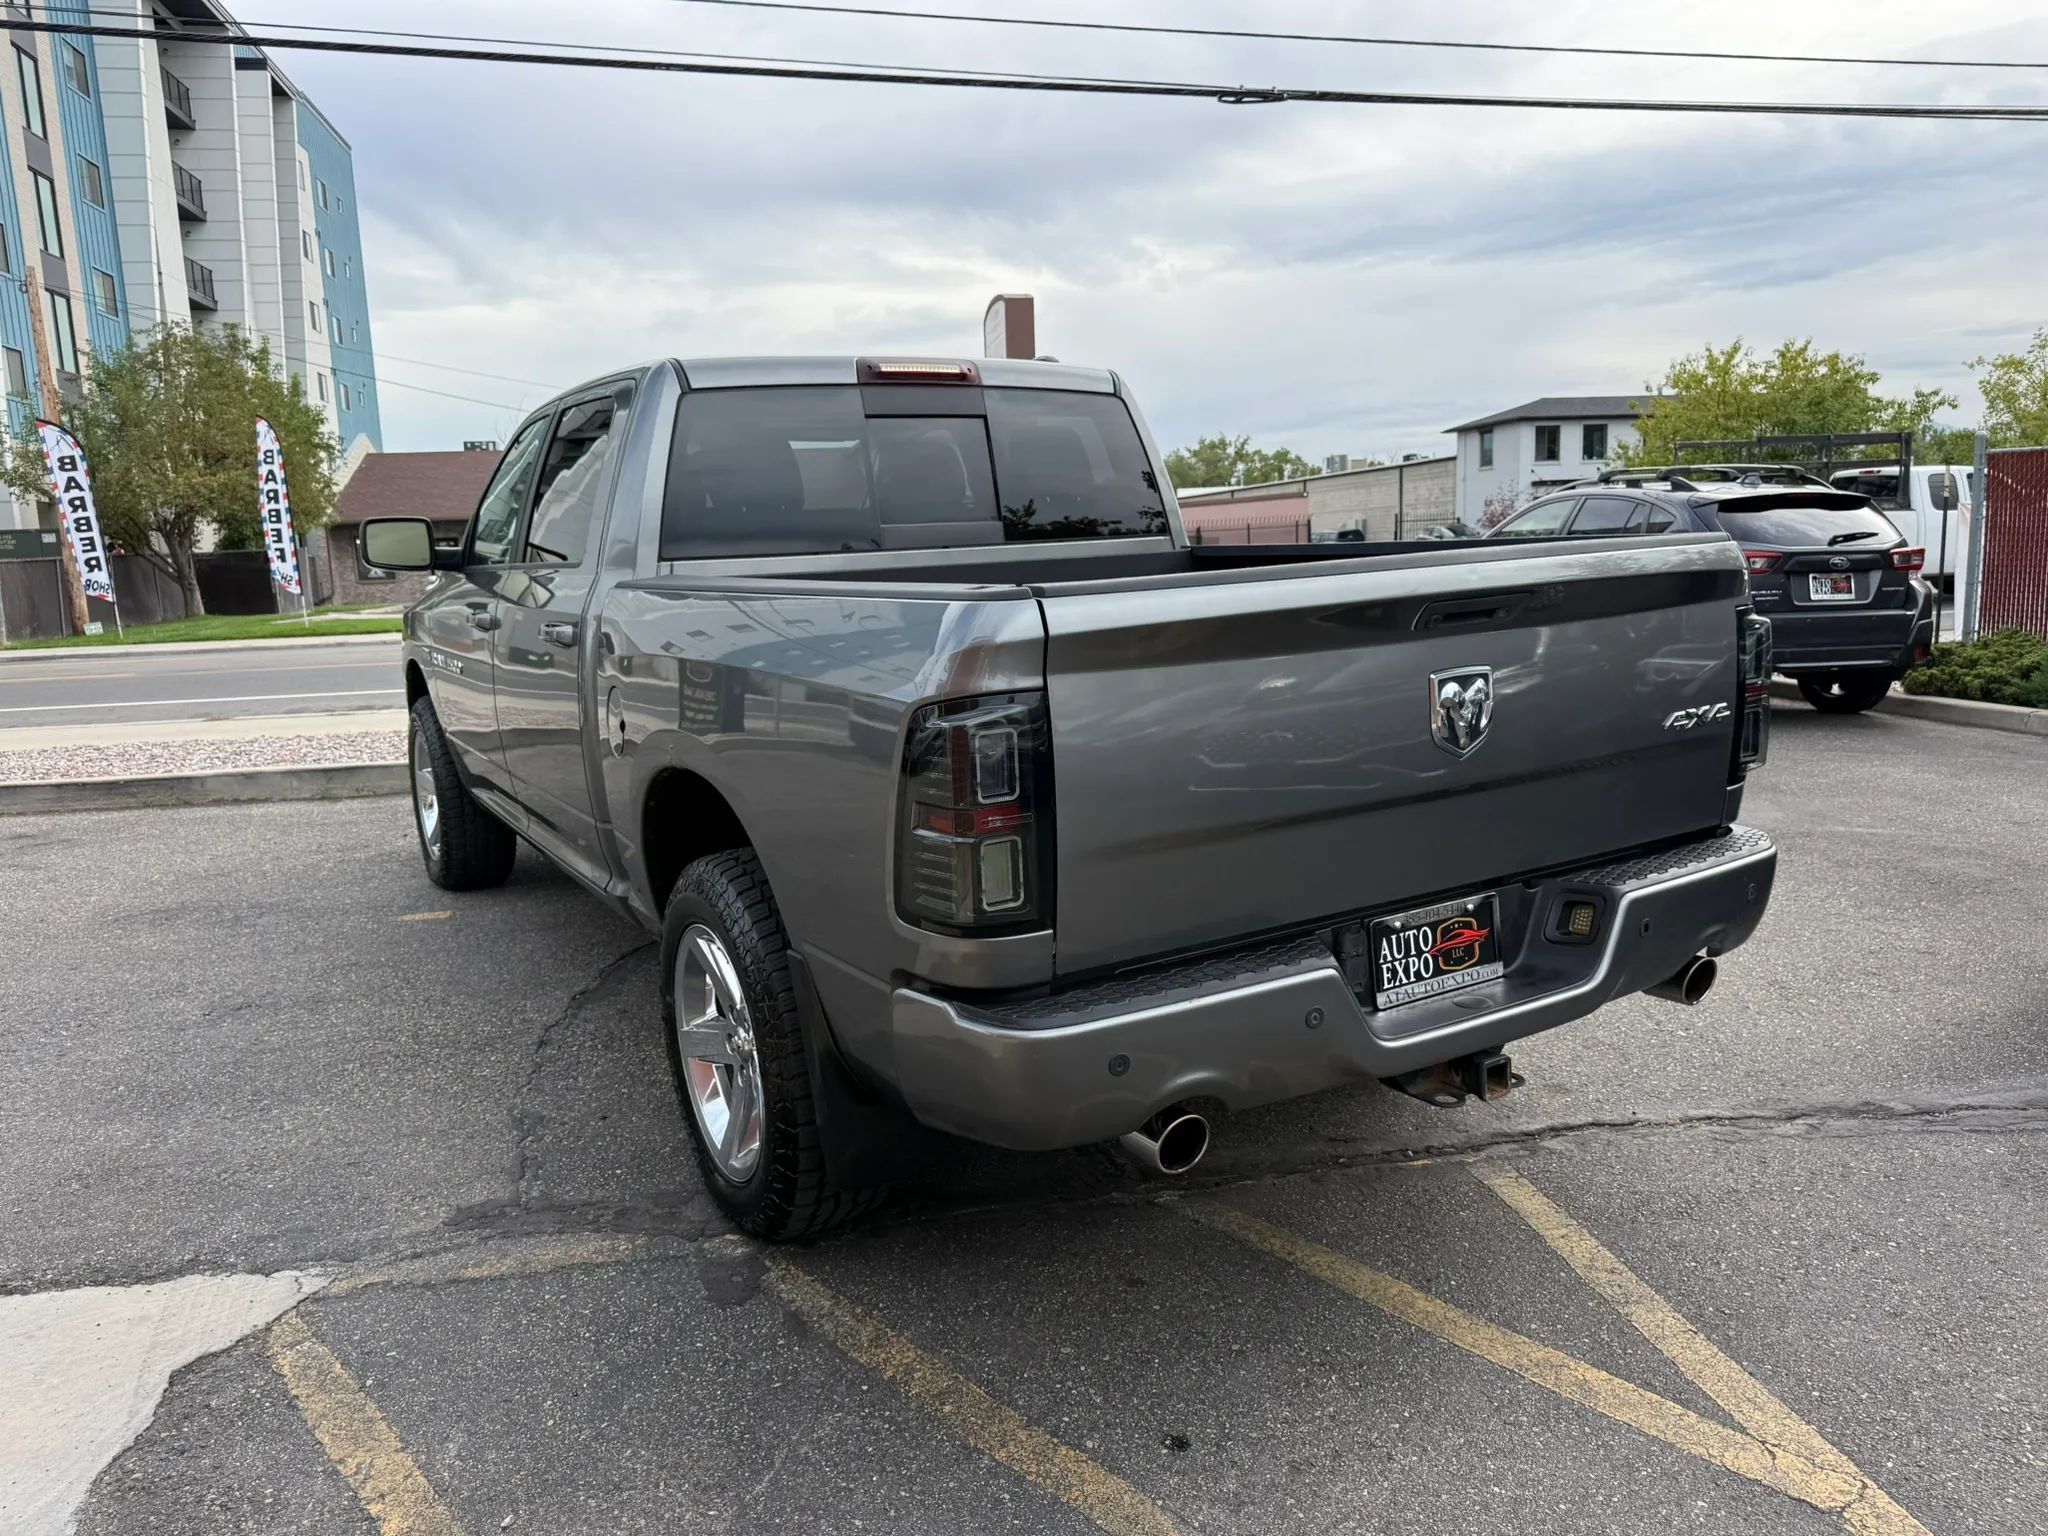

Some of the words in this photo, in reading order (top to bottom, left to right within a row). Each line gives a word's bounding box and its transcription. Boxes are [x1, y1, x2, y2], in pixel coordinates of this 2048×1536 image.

[1812, 579, 1831, 587] AUTO
[1812, 586, 1831, 595] EXPO
[1379, 926, 1433, 963] AUTO
[1452, 947, 1464, 959] LLC
[1382, 953, 1434, 989] EXPO
